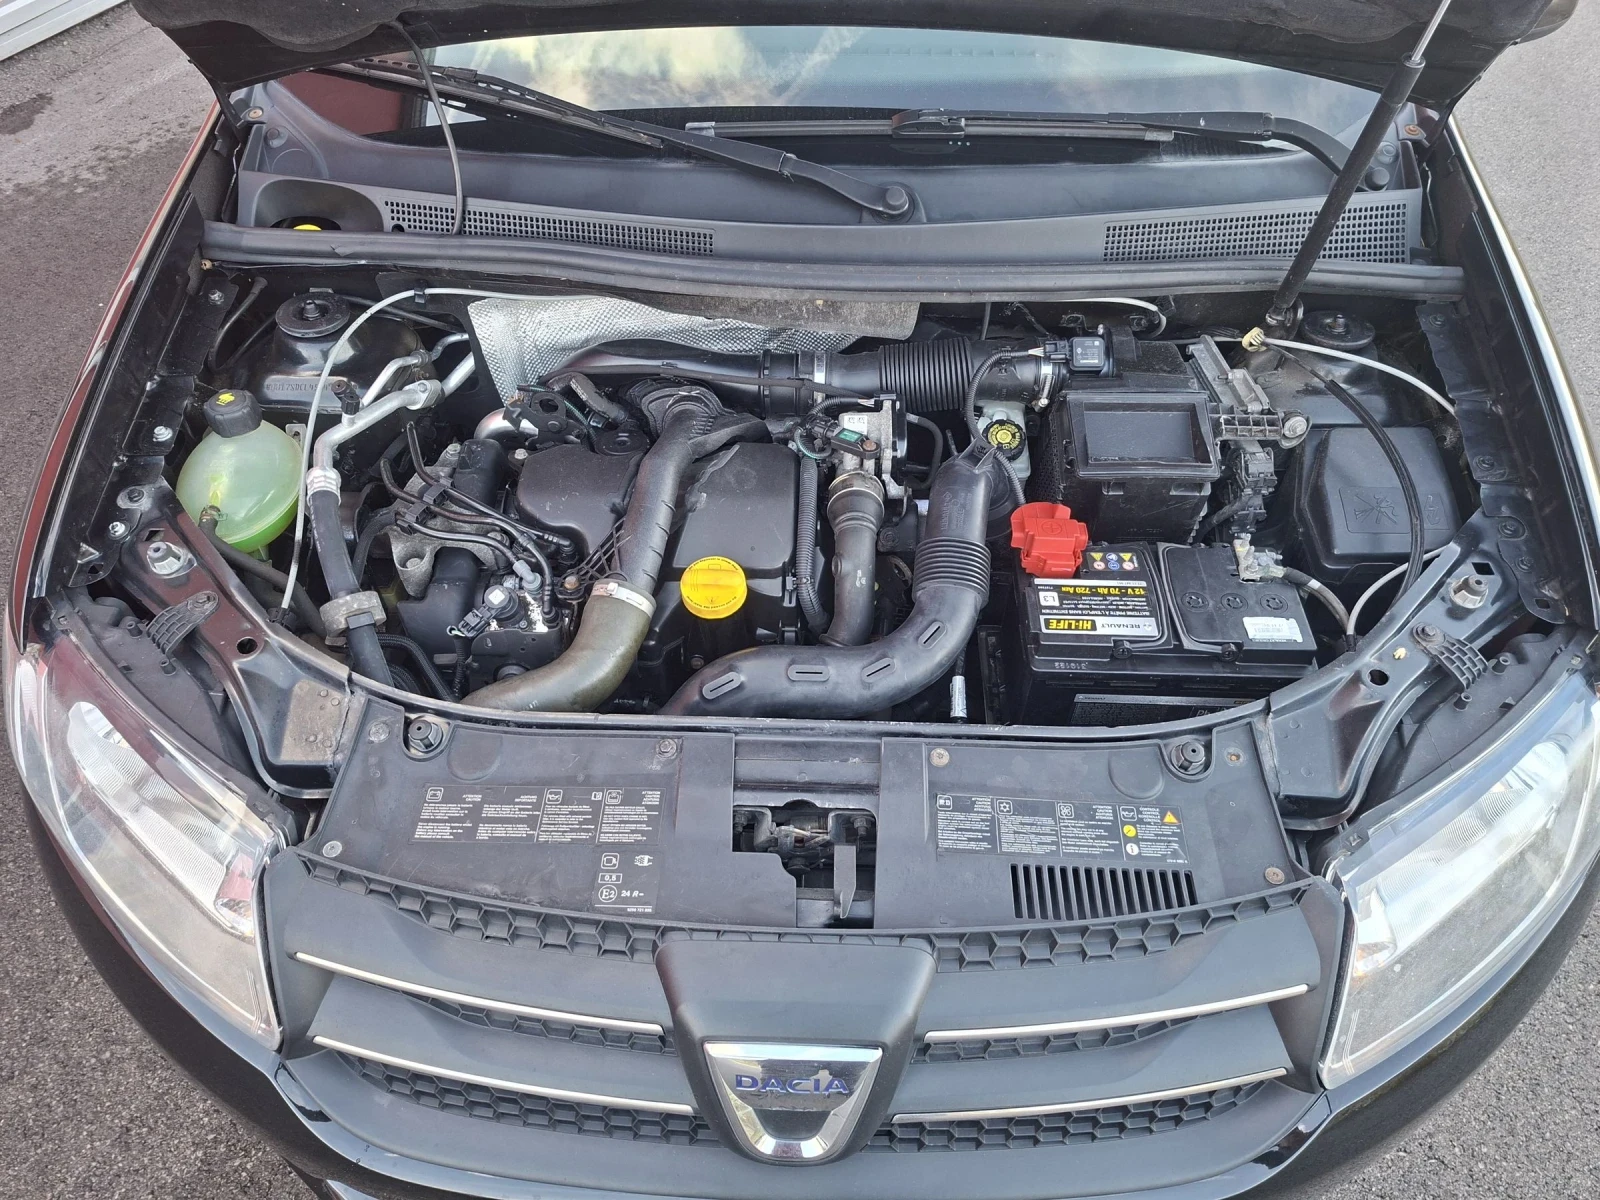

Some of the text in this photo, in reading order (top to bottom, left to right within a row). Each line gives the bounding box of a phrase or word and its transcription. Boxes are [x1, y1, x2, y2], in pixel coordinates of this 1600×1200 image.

[1100, 622, 1141, 630] RENAULT
[601, 888, 615, 899] E2
[735, 1074, 850, 1094] DACIA
